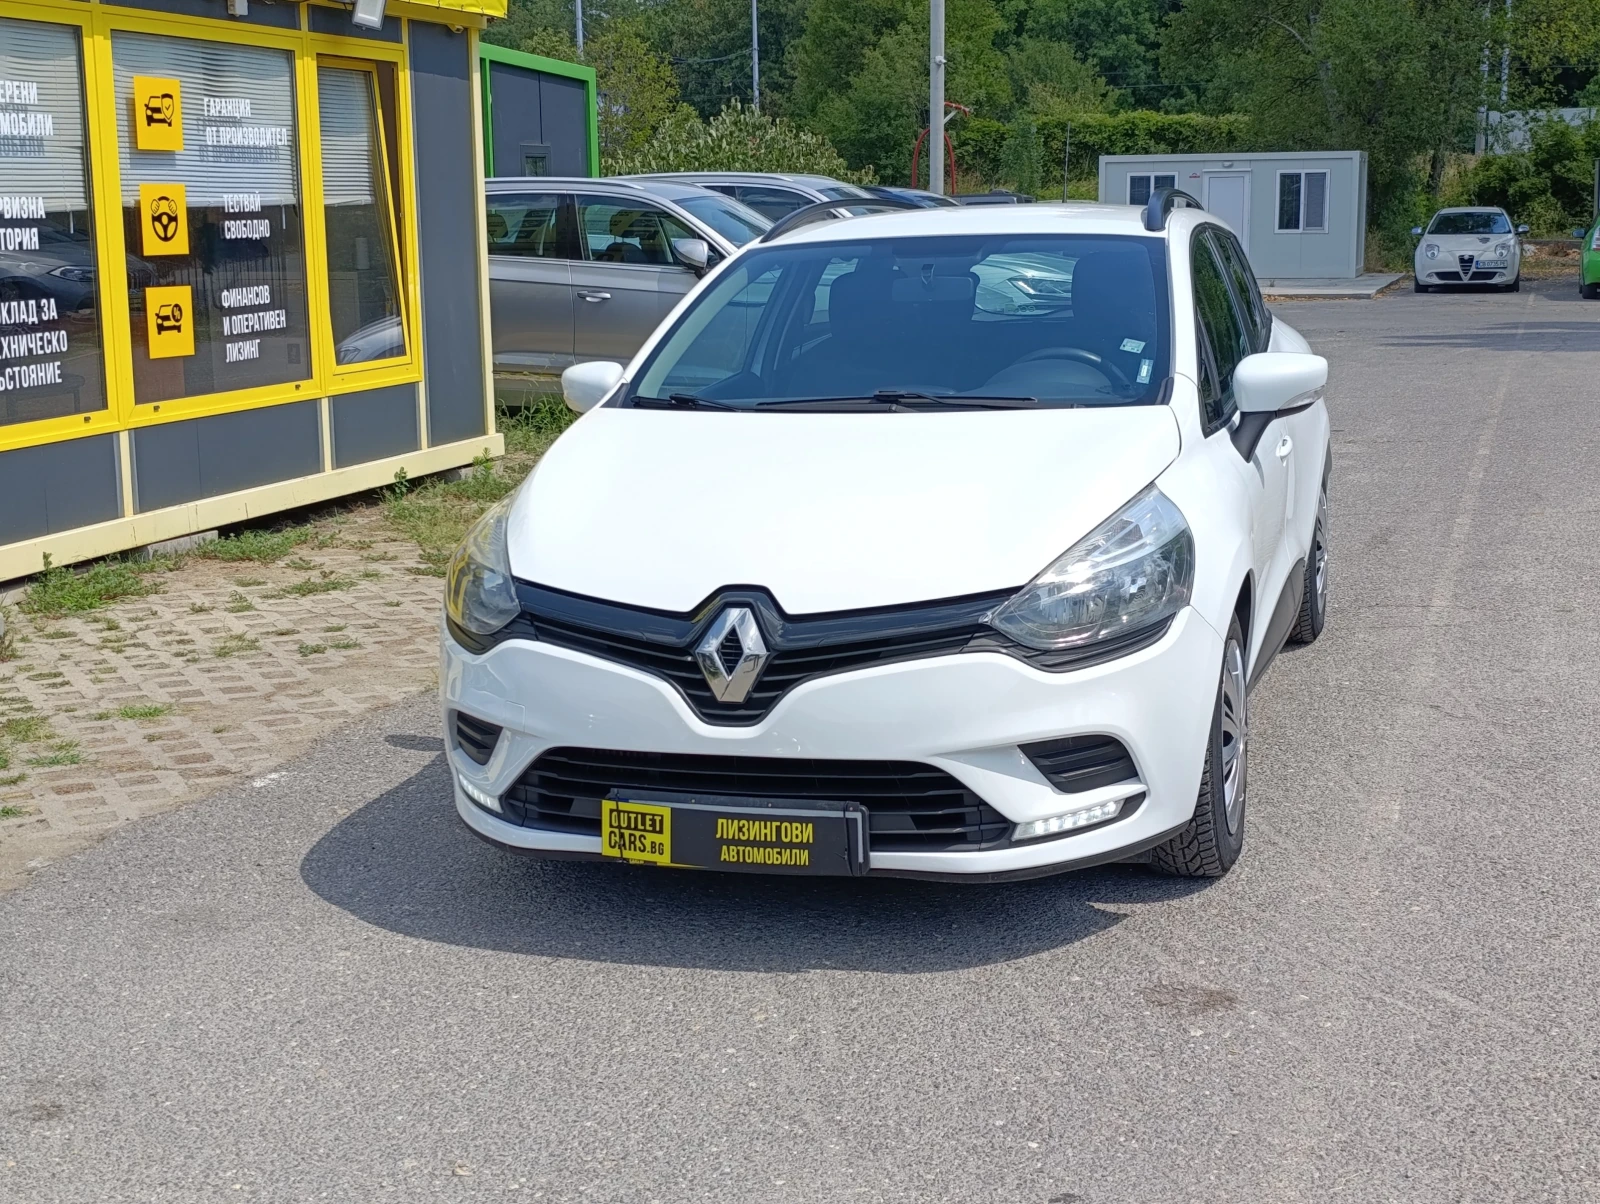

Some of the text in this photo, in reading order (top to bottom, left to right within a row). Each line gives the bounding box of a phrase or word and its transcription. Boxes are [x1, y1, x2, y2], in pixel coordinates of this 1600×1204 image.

[203, 97, 251, 118] ГАРАНЦИЯ
[205, 126, 288, 148] ОТ ПРОИЗВОДИТЕЛ
[222, 191, 261, 213] ТЕСТВАЙ
[224, 219, 270, 240] СВОБОДНО
[221, 285, 271, 309] ФИНАНСОВ
[40, 297, 58, 321] ЗА
[222, 309, 287, 336] И ОПЕРАТИВЕН
[225, 338, 261, 363] ЛИЗИНГ
[611, 811, 662, 832] OUTLET
[715, 818, 814, 844] ЛИЗИНГОВИ
[720, 845, 809, 867] АВТОМОБИЛИ
